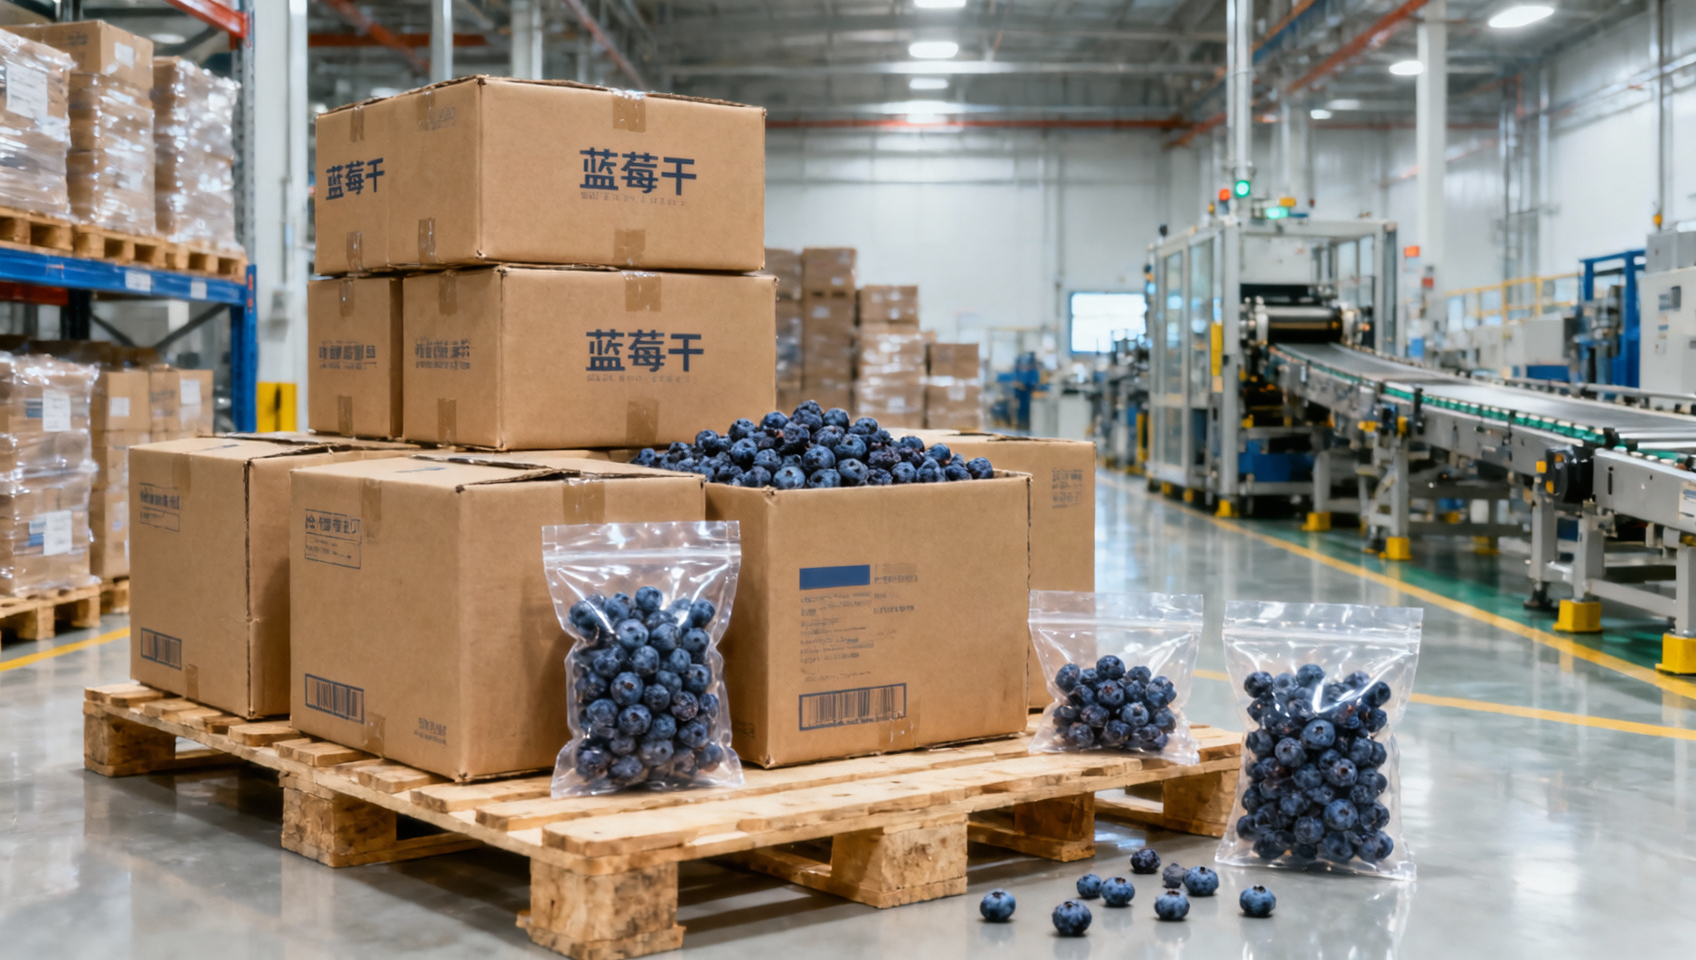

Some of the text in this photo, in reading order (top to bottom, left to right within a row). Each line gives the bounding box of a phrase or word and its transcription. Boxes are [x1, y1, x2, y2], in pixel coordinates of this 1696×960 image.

[325, 157, 385, 200] 蓝莓干
[579, 147, 697, 196] 蓝莓干
[585, 328, 704, 372] 蓝莓干
